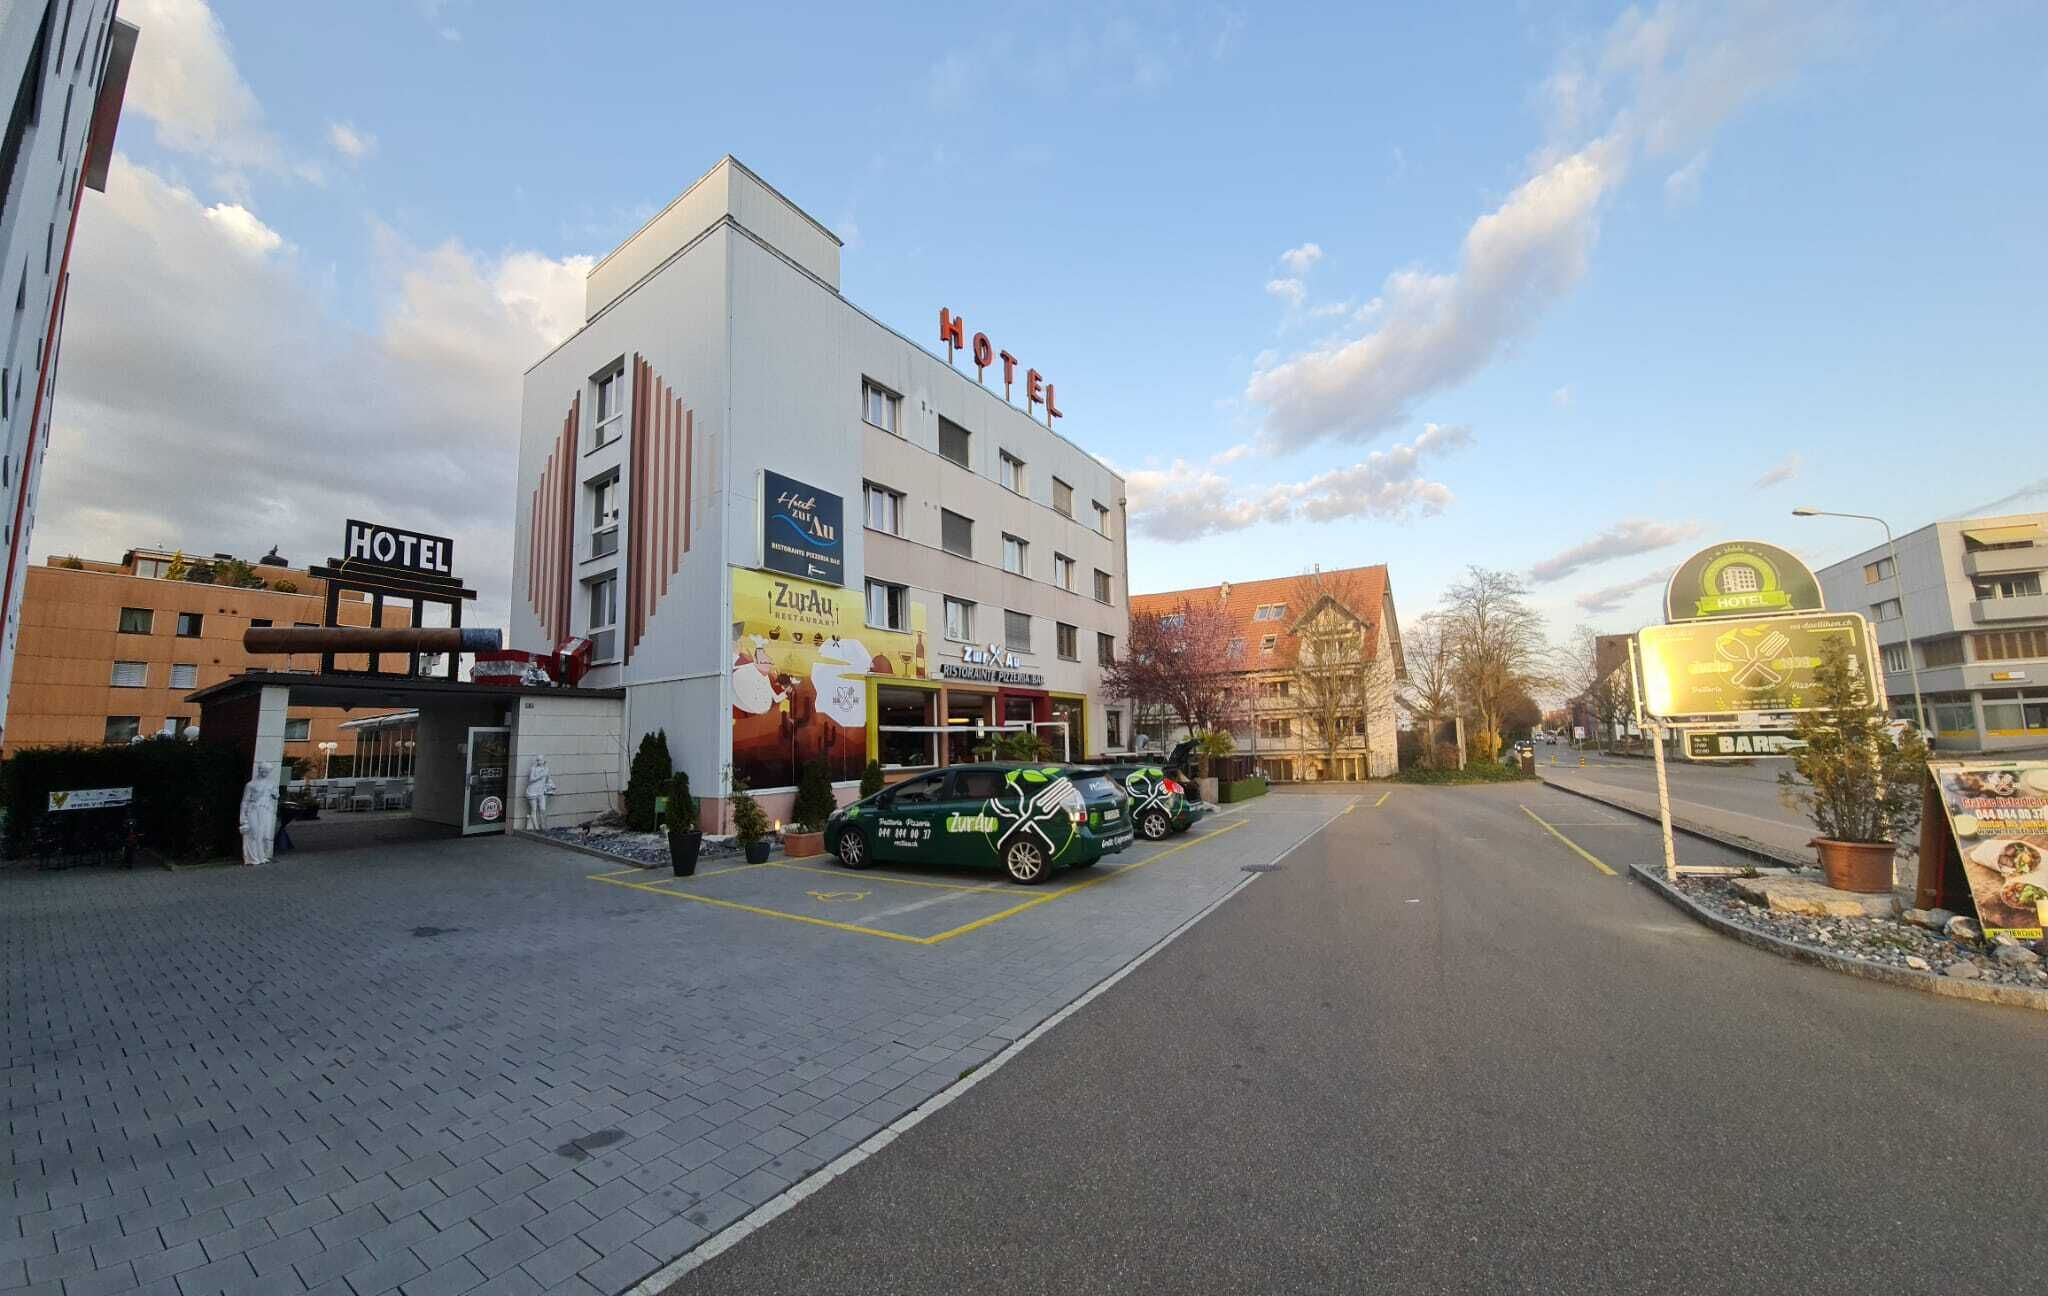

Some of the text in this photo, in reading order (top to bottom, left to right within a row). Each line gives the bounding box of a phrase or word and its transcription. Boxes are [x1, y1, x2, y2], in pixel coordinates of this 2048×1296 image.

[940, 307, 1063, 418] HOTEL
[792, 509, 835, 541] zur Au
[351, 525, 449, 573] HOTEL
[774, 581, 834, 618] ZurAu
[1717, 595, 1765, 609] HOTEL
[775, 610, 836, 628] RESTAURANT
[962, 646, 1024, 669] Zur Au
[951, 811, 995, 832] ZurAu
